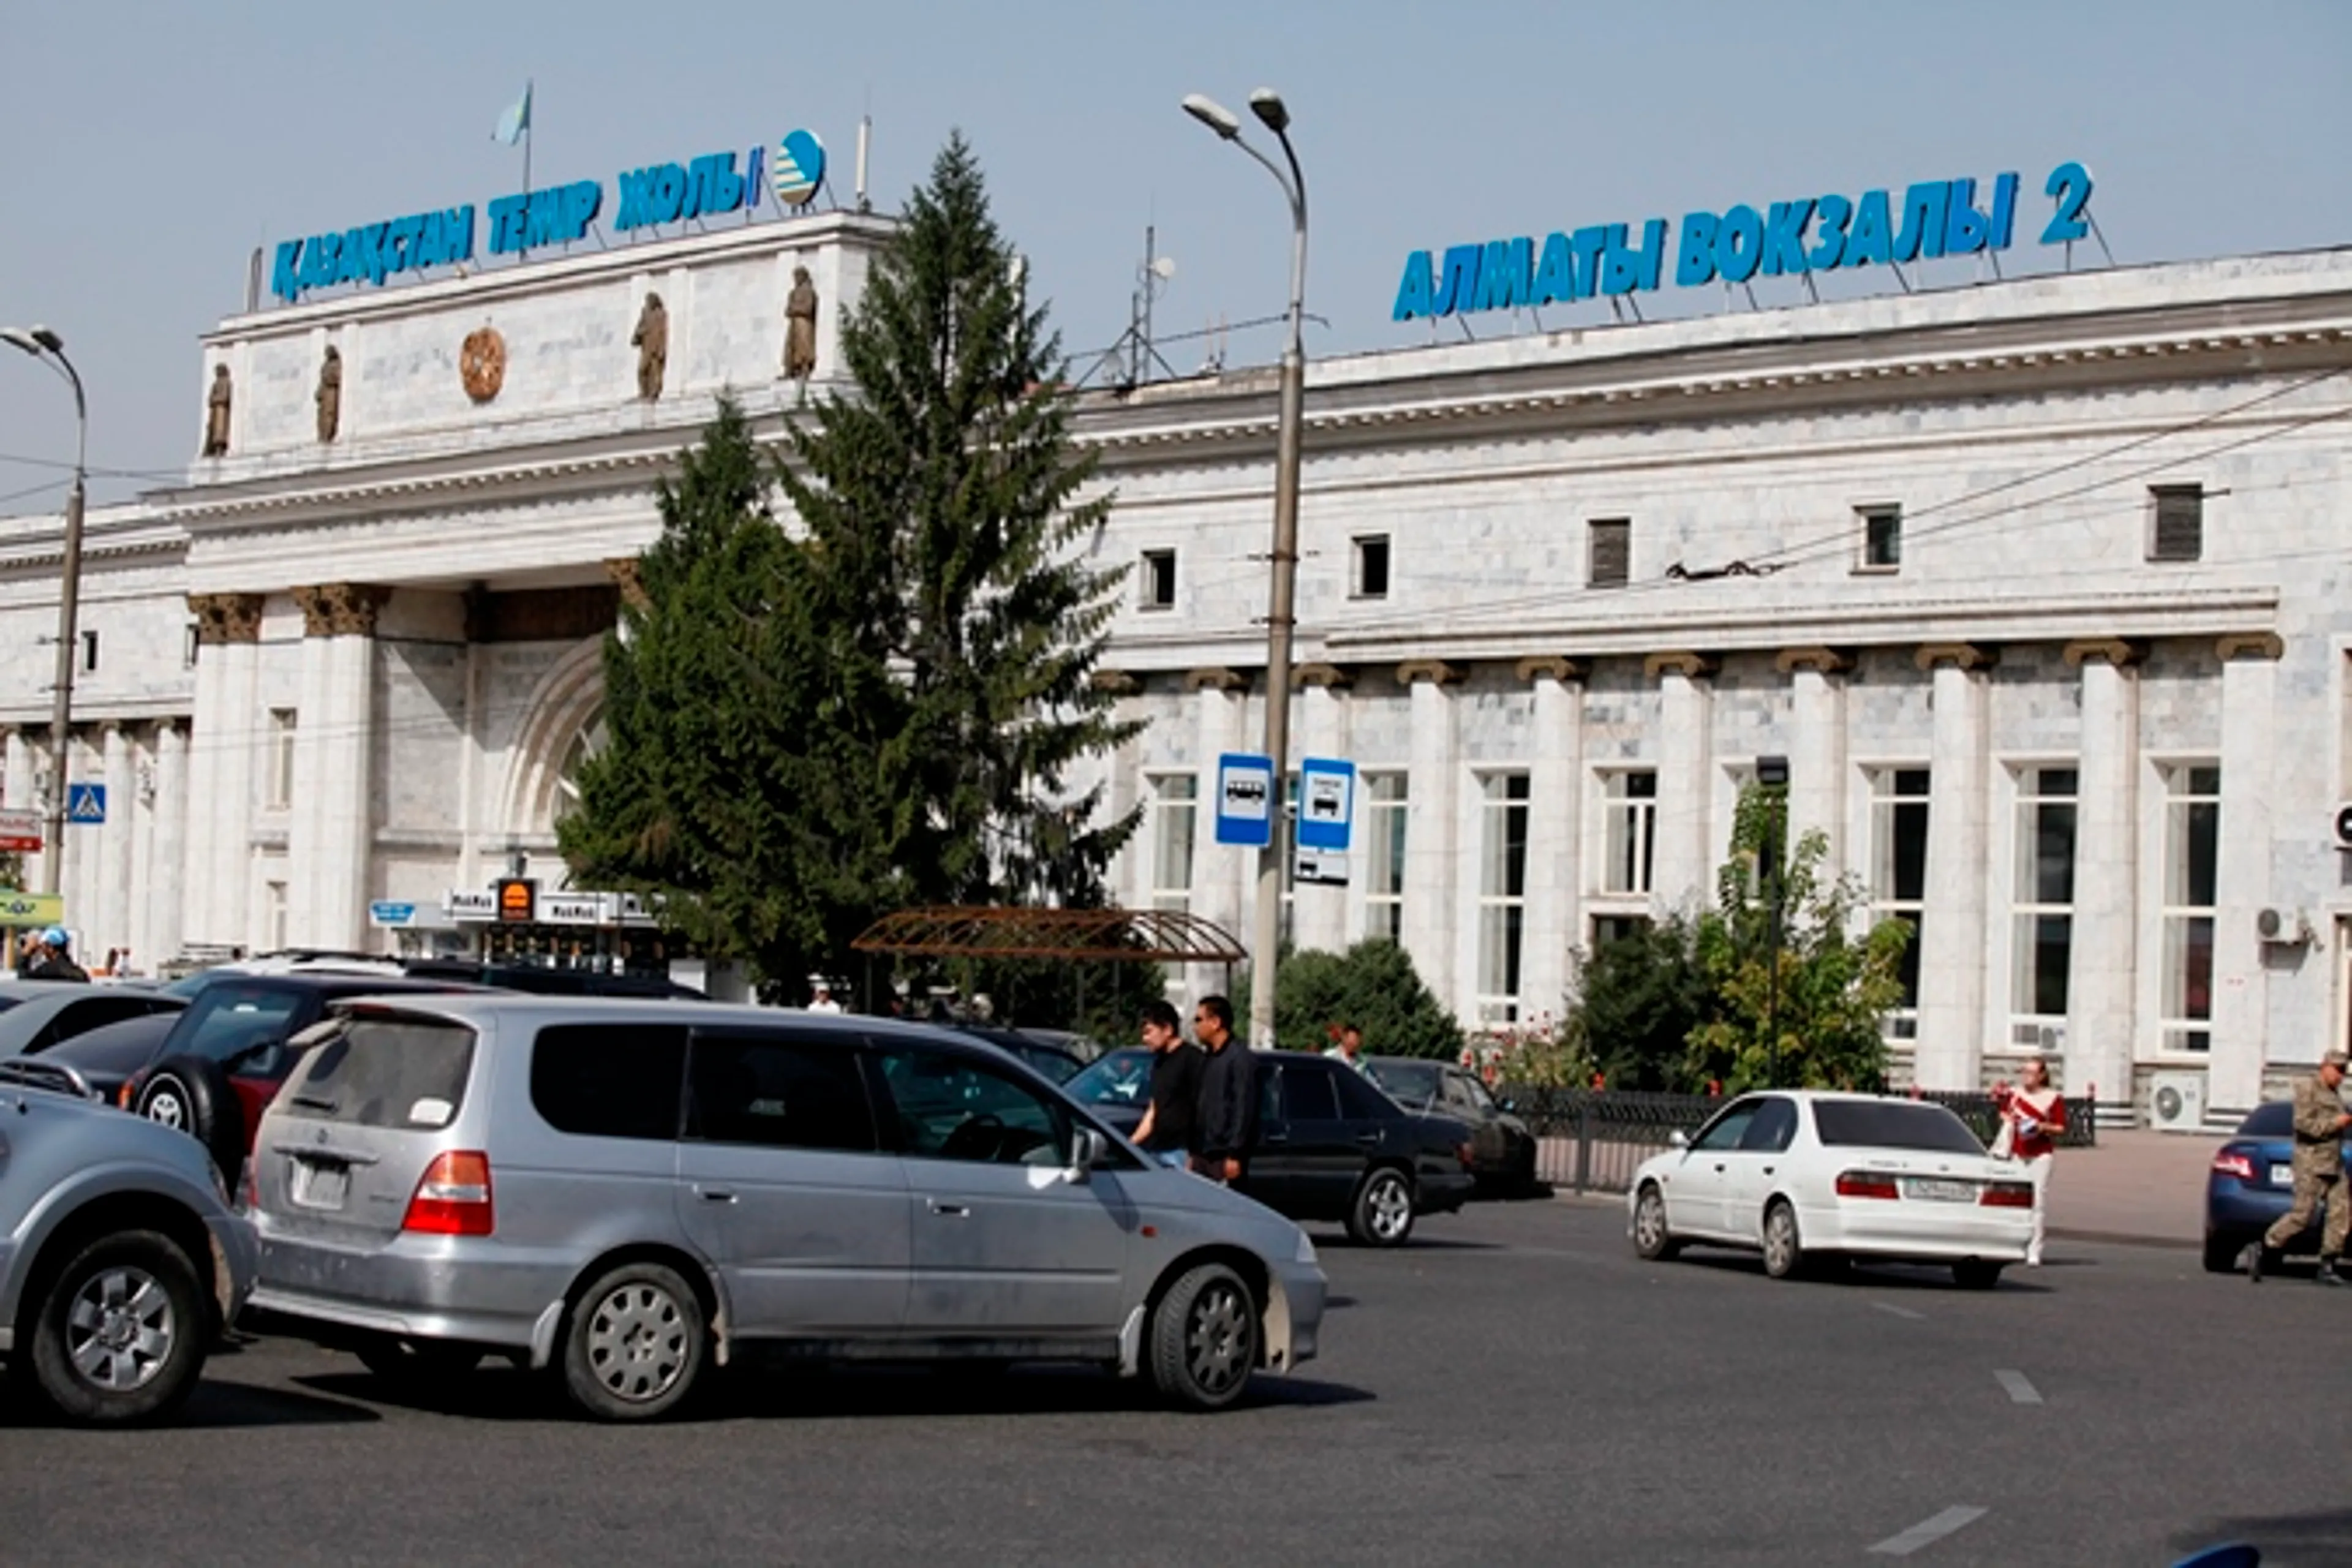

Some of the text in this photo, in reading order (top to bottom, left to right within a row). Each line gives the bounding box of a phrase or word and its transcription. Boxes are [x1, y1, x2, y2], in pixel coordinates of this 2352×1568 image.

[271, 204, 475, 303] ҚАЗАҚСТАН
[614, 146, 764, 231] ЖОЛЫ
[1392, 161, 2092, 321] АЛМАТЫ ВОКЗАЛЫ 2
